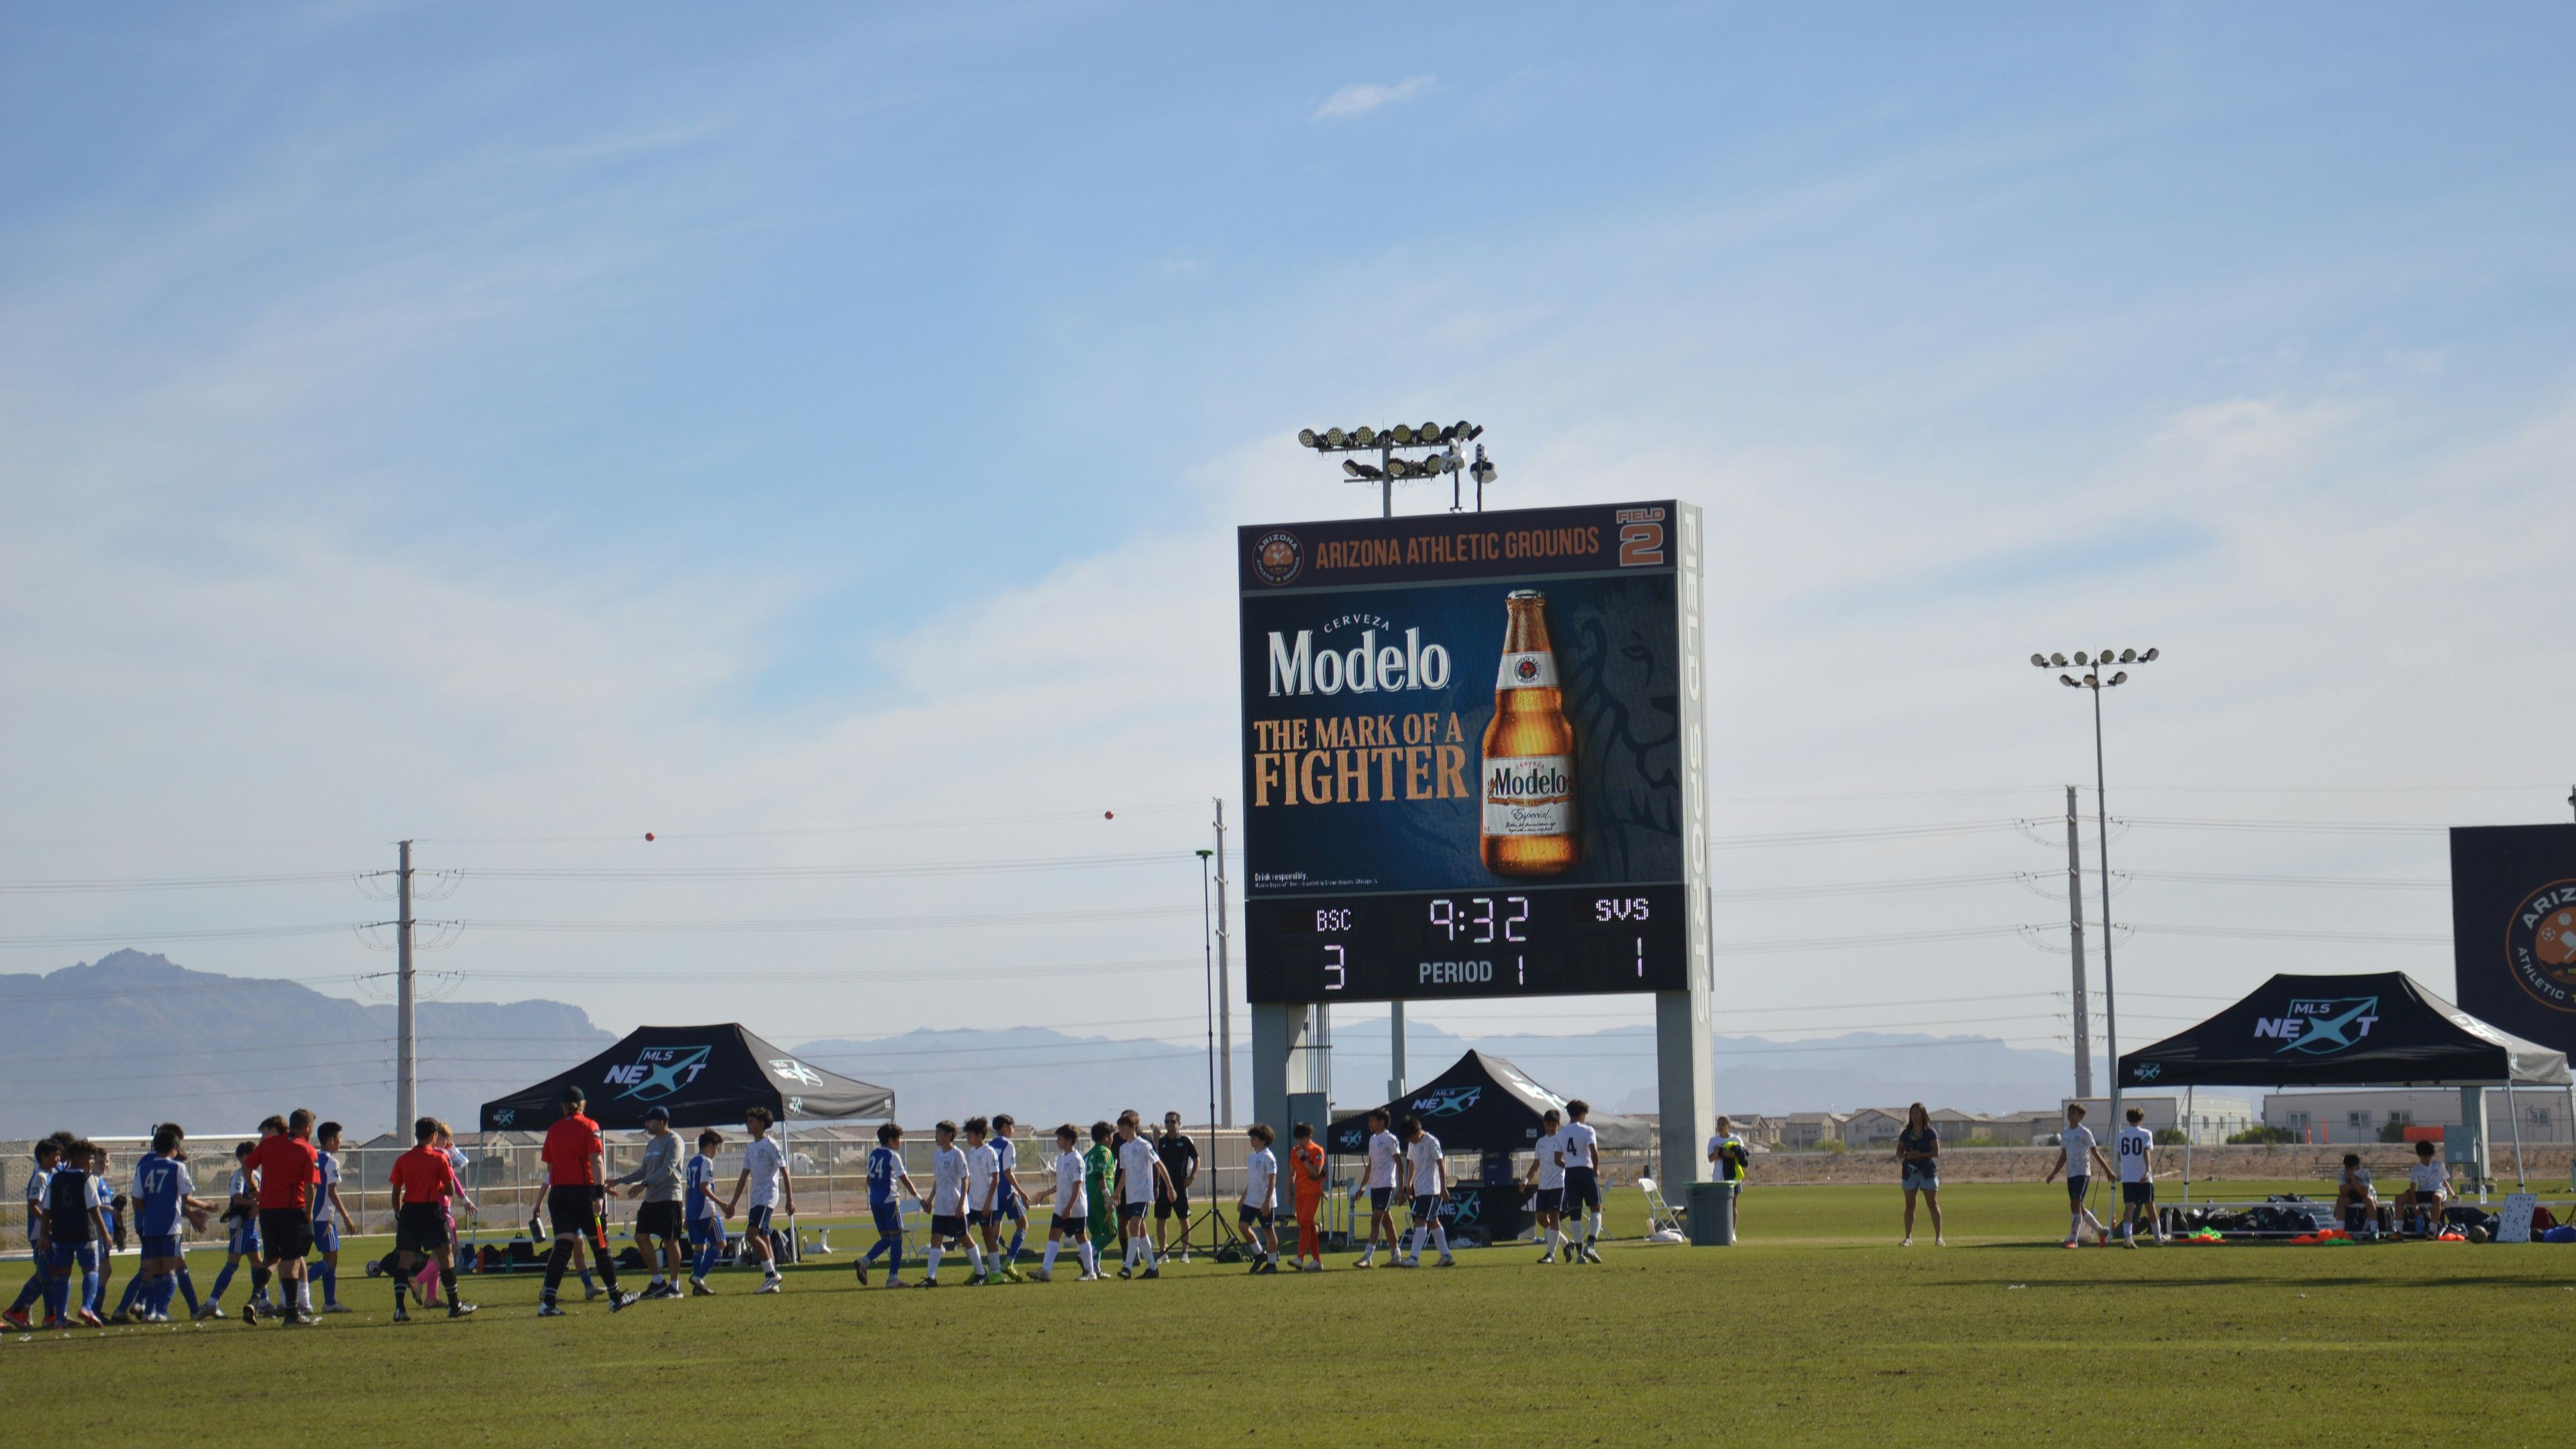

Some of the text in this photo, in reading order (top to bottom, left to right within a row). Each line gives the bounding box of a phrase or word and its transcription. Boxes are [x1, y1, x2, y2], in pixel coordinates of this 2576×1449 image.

[1616, 507, 1665, 524] FIELD
[1258, 533, 1297, 553] ARIZONA
[1316, 526, 1600, 569] ARIZONA ATHLETIC GROUNDS
[1619, 523, 1664, 567] 2
[1684, 512, 1699, 702] FIELD
[1324, 614, 1389, 633] CERVEZA
[1268, 626, 1450, 697] Modelo
[1254, 711, 1464, 751] THE MARK OF A
[1254, 745, 1469, 807] FIGHTER
[1495, 767, 1566, 796] Modelo
[1254, 873, 1271, 882] Drink
[1689, 722, 1709, 1024] SPORTS
[1317, 908, 1351, 932] BSC
[1430, 896, 1528, 943] 9:32
[1596, 898, 1649, 922] SVS
[1324, 945, 1345, 990] 3
[1419, 955, 1523, 985] PERIOD 1
[1637, 936, 1642, 977] 1
[2518, 947, 2565, 1000] ATHLETIC
[2294, 1003, 2330, 1014] MLS
[643, 1051, 674, 1061] MLS
[1567, 1136, 1577, 1157] 4
[2121, 1136, 2143, 1156] 60
[144, 1169, 169, 1194] 47
[869, 1155, 884, 1179] 24
